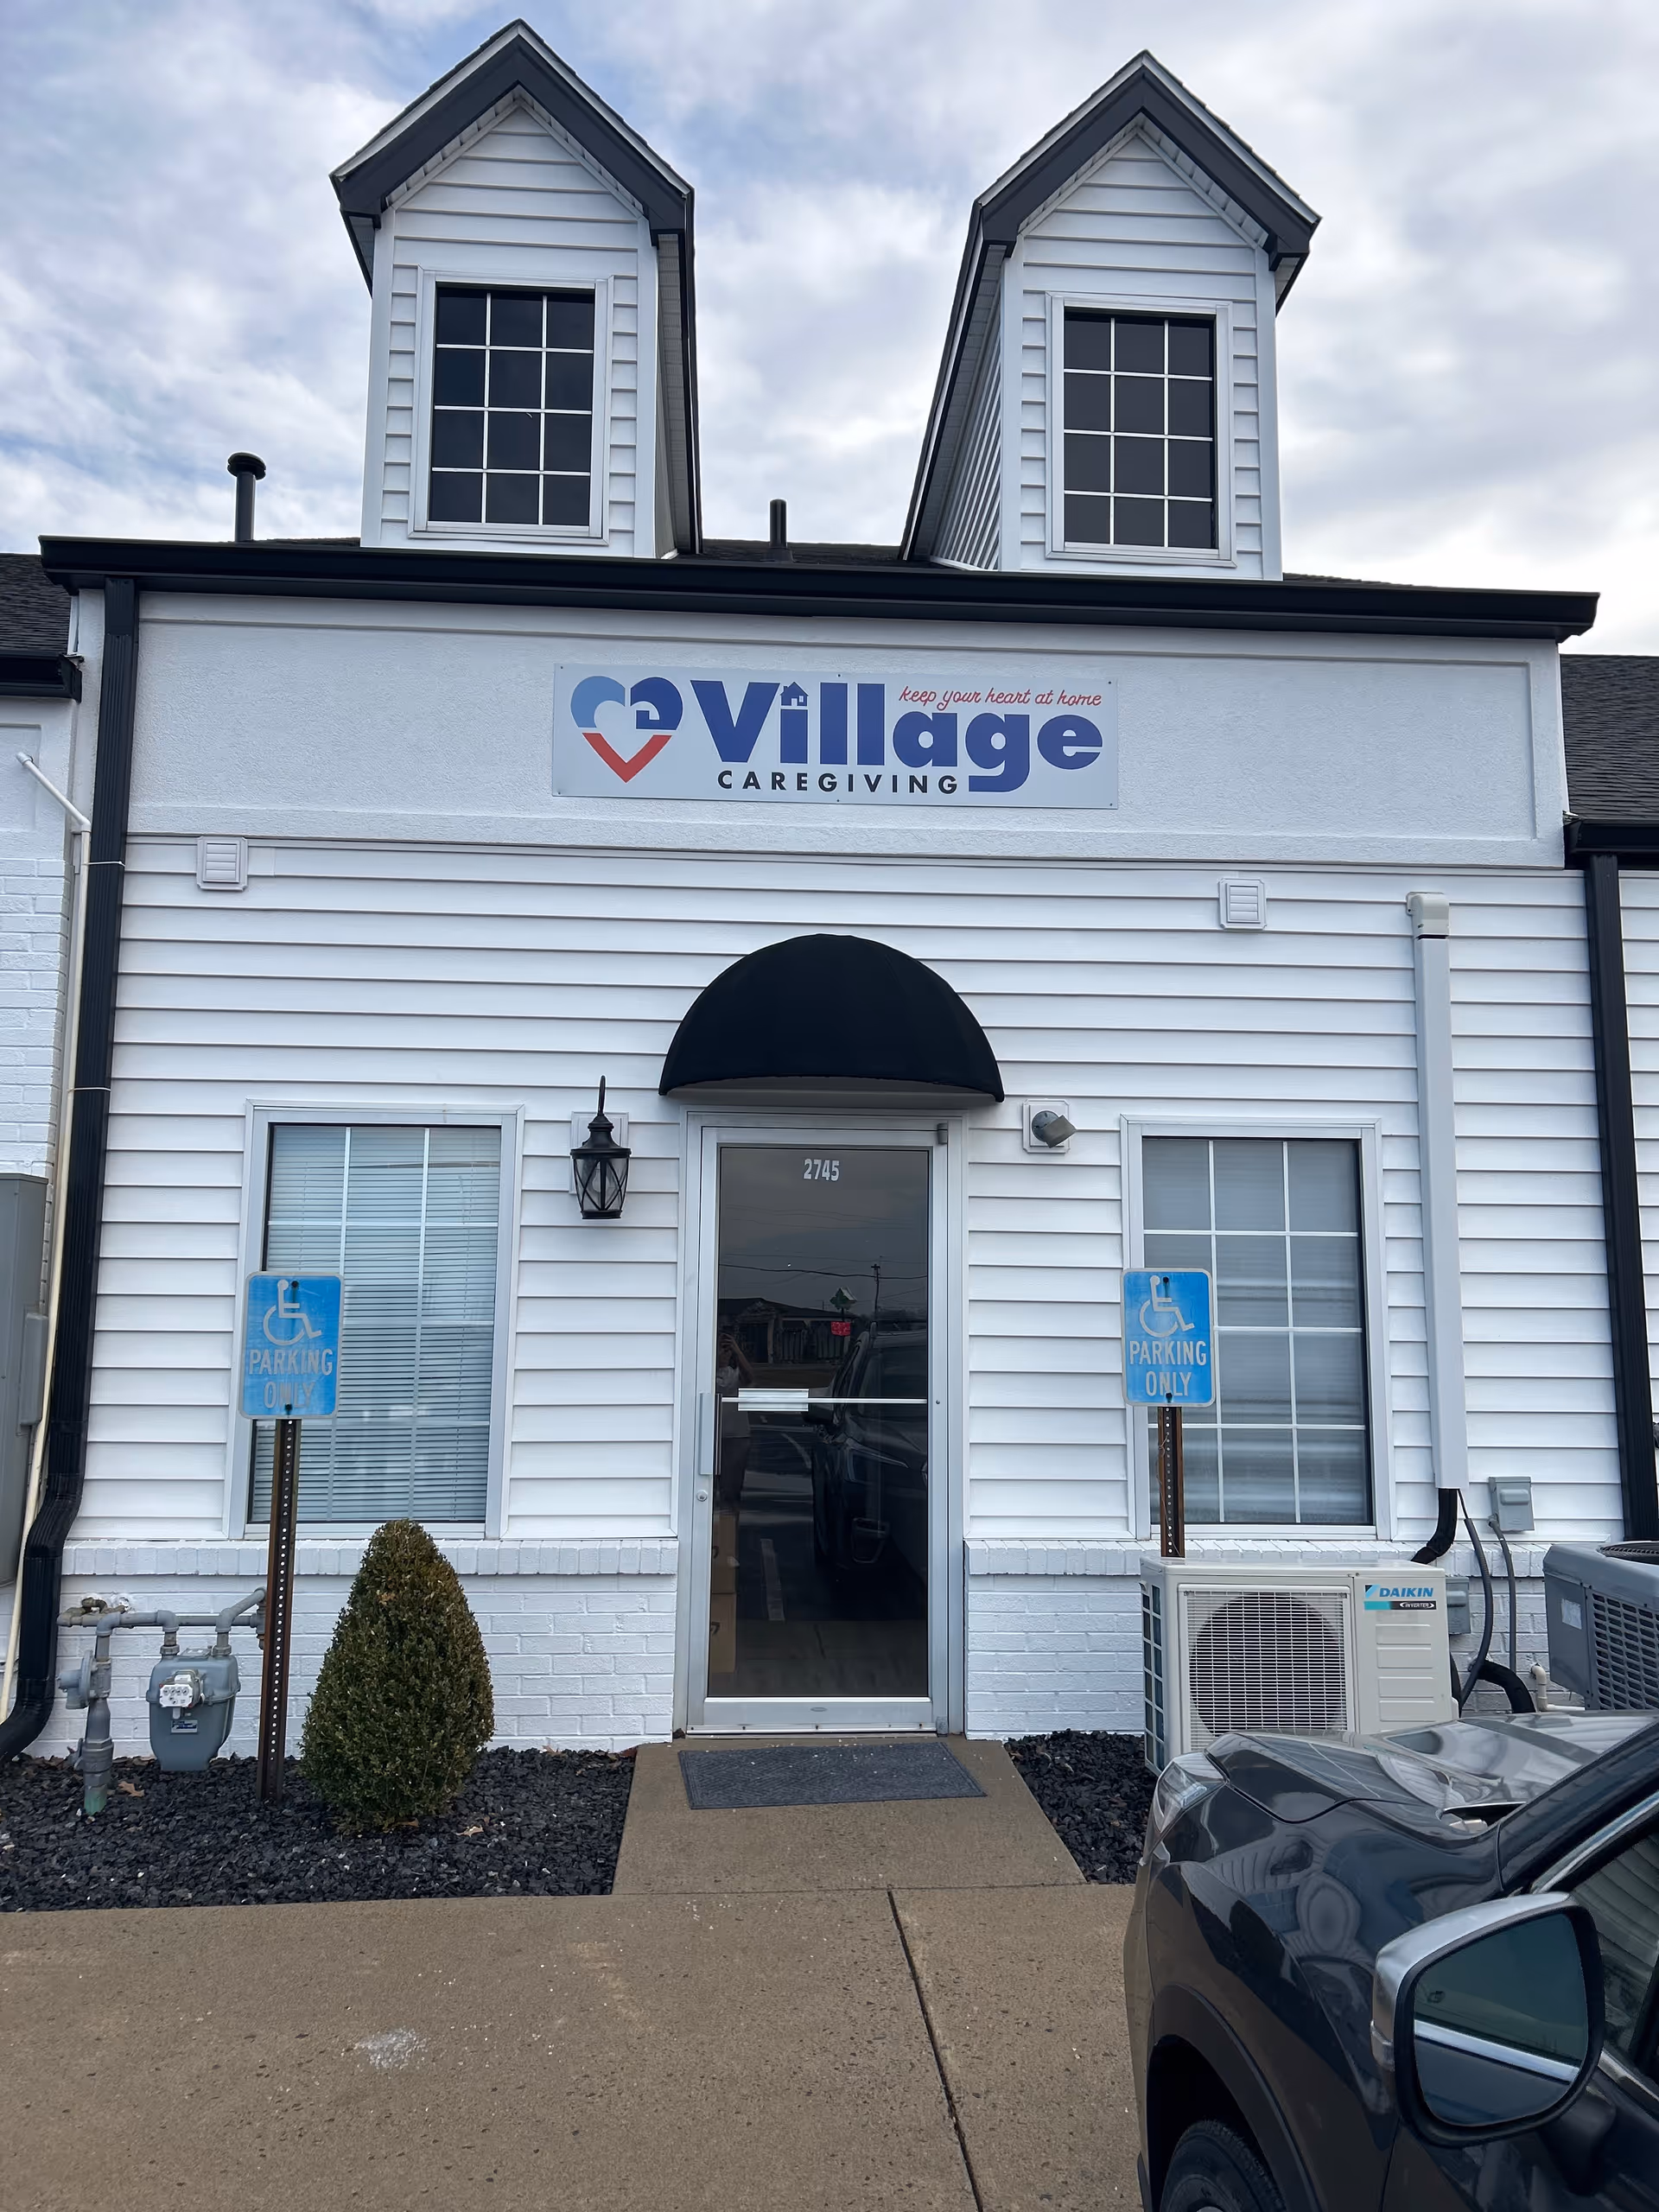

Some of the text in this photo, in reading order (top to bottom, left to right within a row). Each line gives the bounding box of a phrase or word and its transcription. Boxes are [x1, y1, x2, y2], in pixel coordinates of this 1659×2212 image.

[899, 686, 1102, 711] keep your heart at home
[690, 680, 1103, 792] Village
[717, 770, 957, 794] CAREGIVING
[803, 1158, 840, 1181] 2745
[249, 1349, 333, 1376] PARKING
[1129, 1341, 1207, 1366] PARKING
[264, 1381, 315, 1408] ONLY
[1146, 1371, 1192, 1396] ONLY
[1379, 1587, 1433, 1598] DAIKIN
